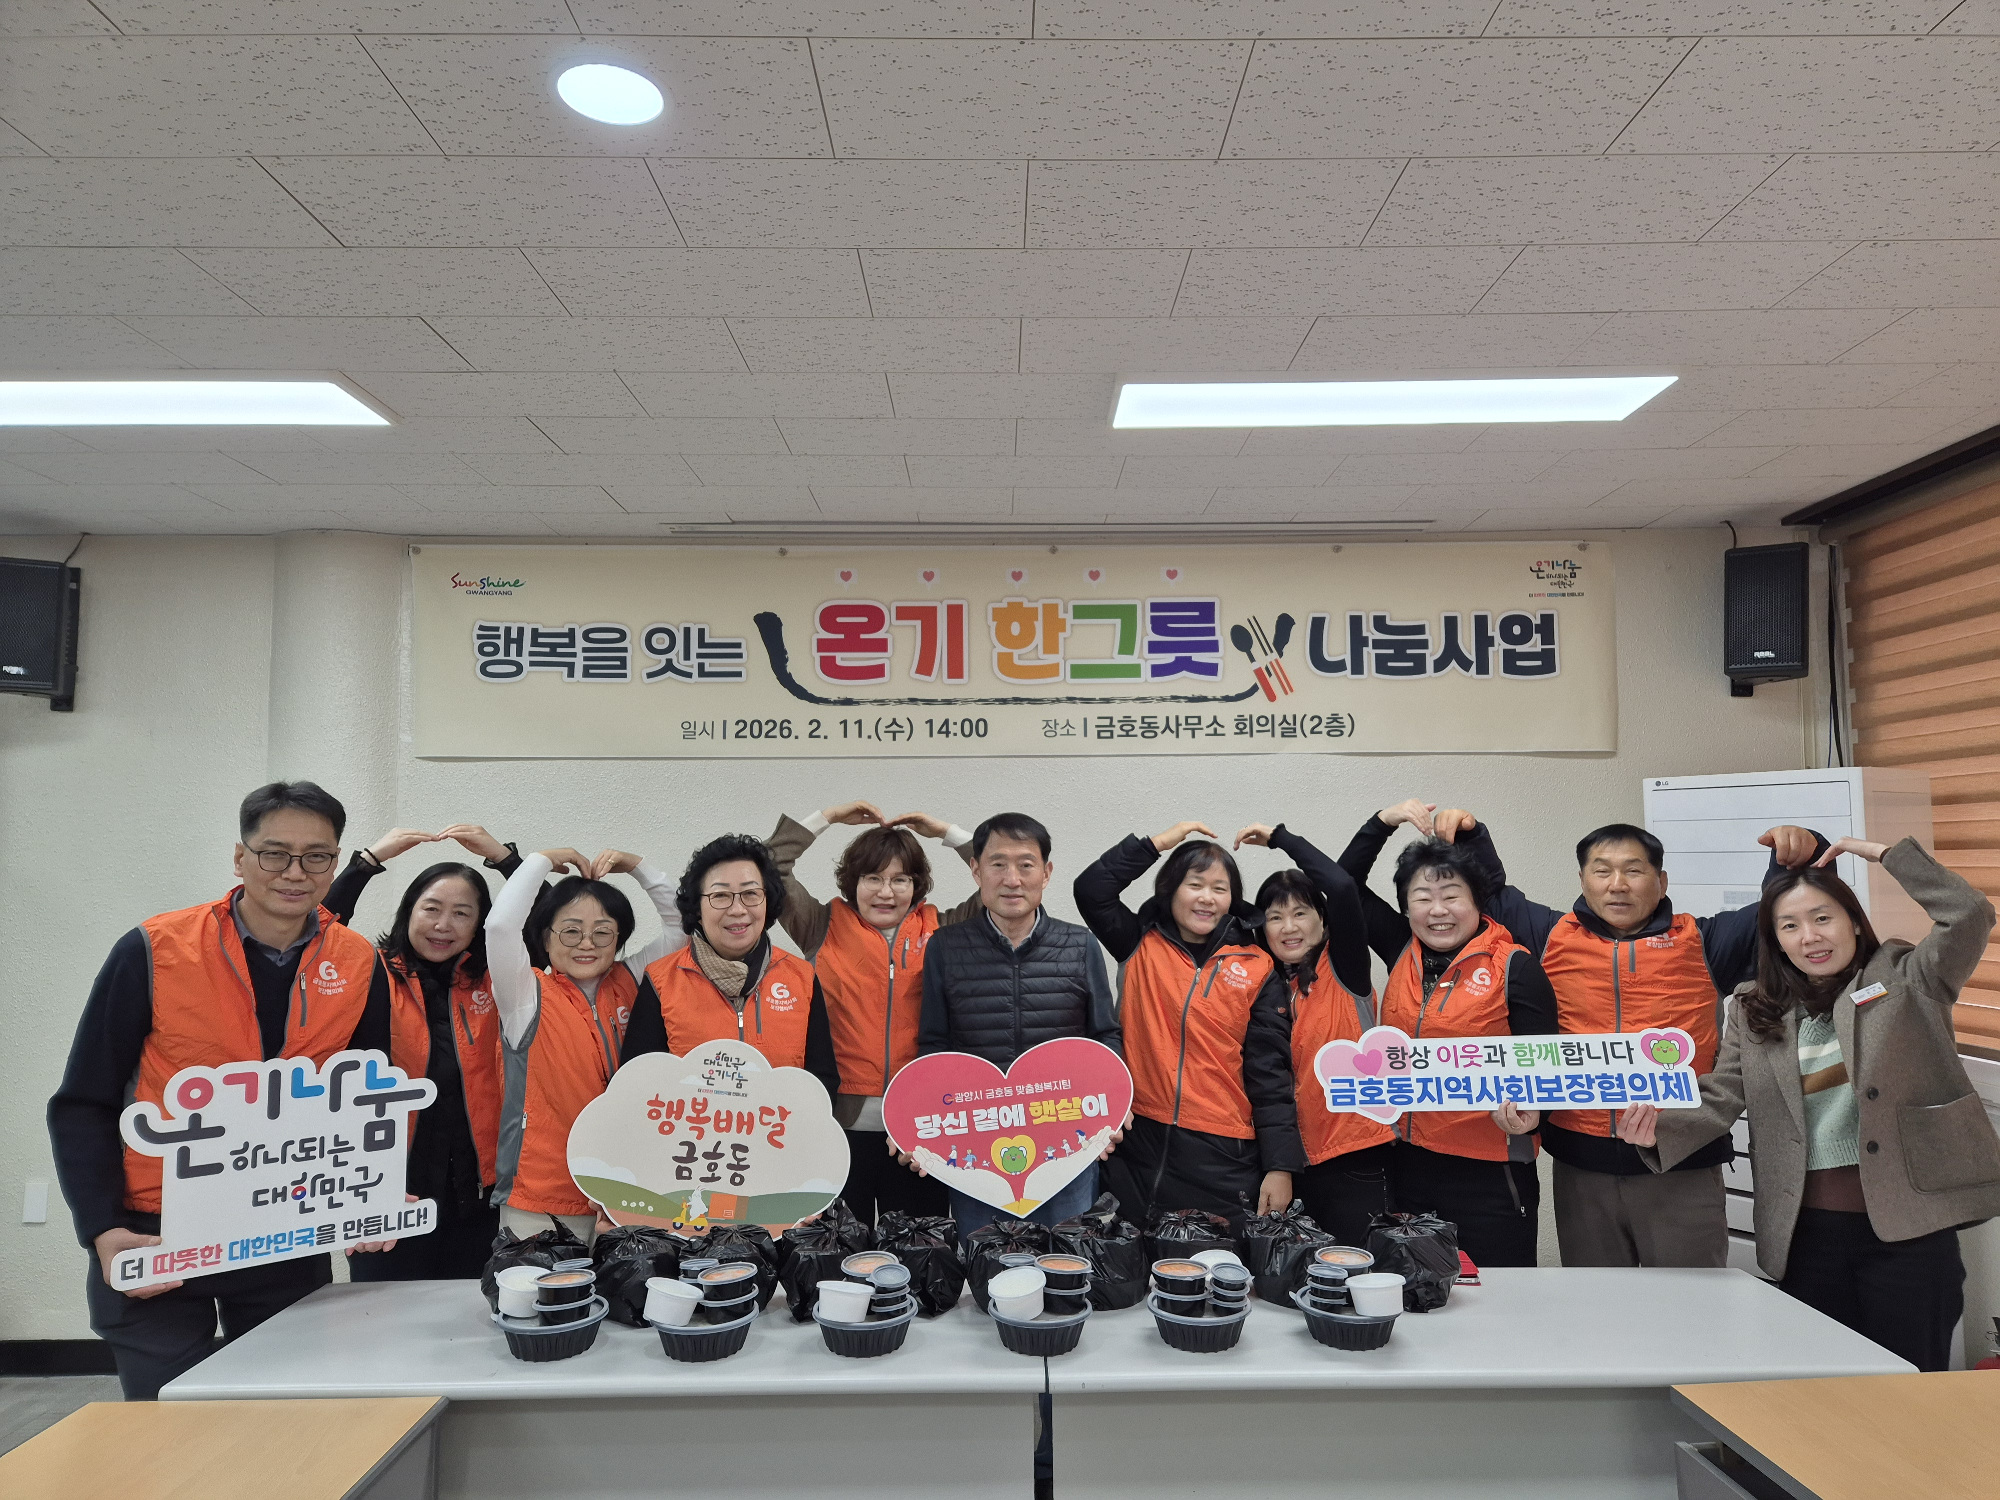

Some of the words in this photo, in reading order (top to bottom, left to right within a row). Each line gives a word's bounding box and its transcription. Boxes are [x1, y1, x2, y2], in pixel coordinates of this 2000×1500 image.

[451, 572, 526, 590] Sunshine
[1529, 559, 1582, 580] 온기나눔
[476, 623, 629, 680] 행복을
[643, 626, 745, 680] 잇는
[816, 603, 966, 681] 온기
[991, 601, 1220, 680] 한그릇
[1308, 612, 1557, 677] 나눔사업
[681, 721, 716, 740] 일시
[734, 718, 800, 740] 2026.
[807, 718, 829, 740] 2.
[839, 716, 914, 742] 11.(수)
[924, 717, 989, 739] 14:00
[1041, 718, 1077, 737] 장소
[1094, 714, 1227, 739] 금호동사무소
[1233, 712, 1356, 739] 회의실(2층)
[703, 1051, 746, 1071] 대한민국
[1385, 1044, 1431, 1070] 항상
[1436, 1043, 1507, 1069] 이웃과
[1512, 1040, 1635, 1067] 함께합니다
[701, 1069, 749, 1089] 온기나눔
[955, 1092, 983, 1103] 광양시
[986, 1087, 1013, 1100] 금호동
[1016, 1079, 1071, 1095] 맞춤형복지팀
[1330, 1072, 1693, 1106] 금호동지역사회보장협의체
[133, 1060, 427, 1179] 온기나눔
[647, 1094, 791, 1149] 행복배달
[914, 1111, 968, 1139] 당신
[973, 1103, 1026, 1131] 곁에
[1029, 1094, 1108, 1125] 햇살이
[229, 1134, 355, 1171] 하나되는
[672, 1141, 750, 1186] 금호동
[251, 1166, 384, 1214] 대한민국
[120, 1257, 144, 1281] 더
[152, 1243, 223, 1275] 따뜻한
[227, 1223, 336, 1261] 대한민국을
[342, 1207, 429, 1241] 만듭니다!
